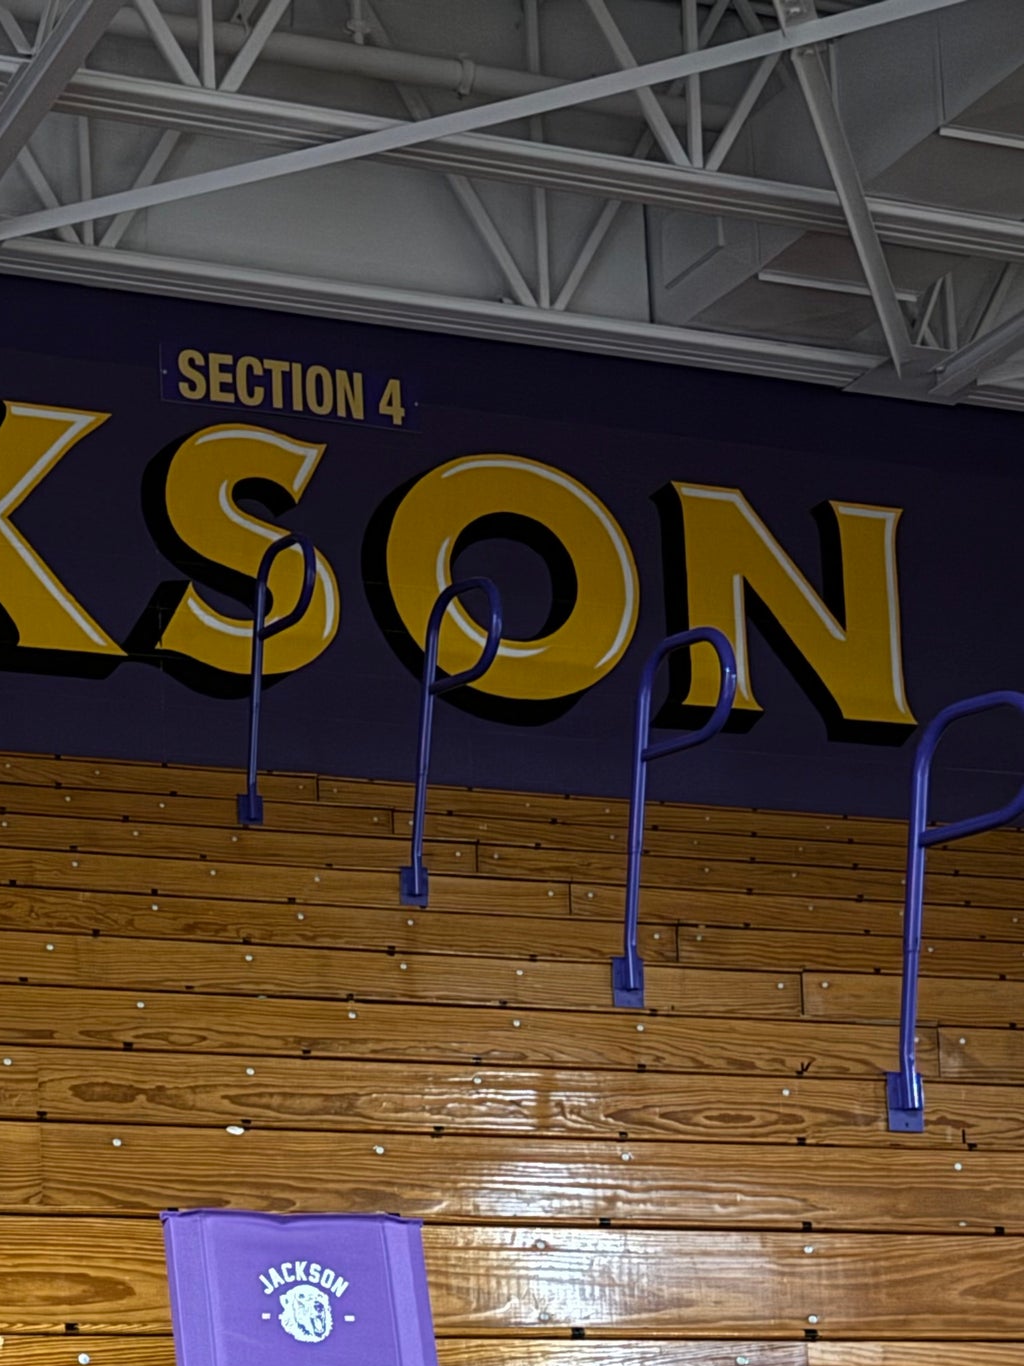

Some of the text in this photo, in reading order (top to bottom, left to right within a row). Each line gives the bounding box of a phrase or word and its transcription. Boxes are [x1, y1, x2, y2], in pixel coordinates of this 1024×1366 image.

[177, 348, 406, 426] SECTION 4
[258, 1260, 350, 1299] JACKSON
